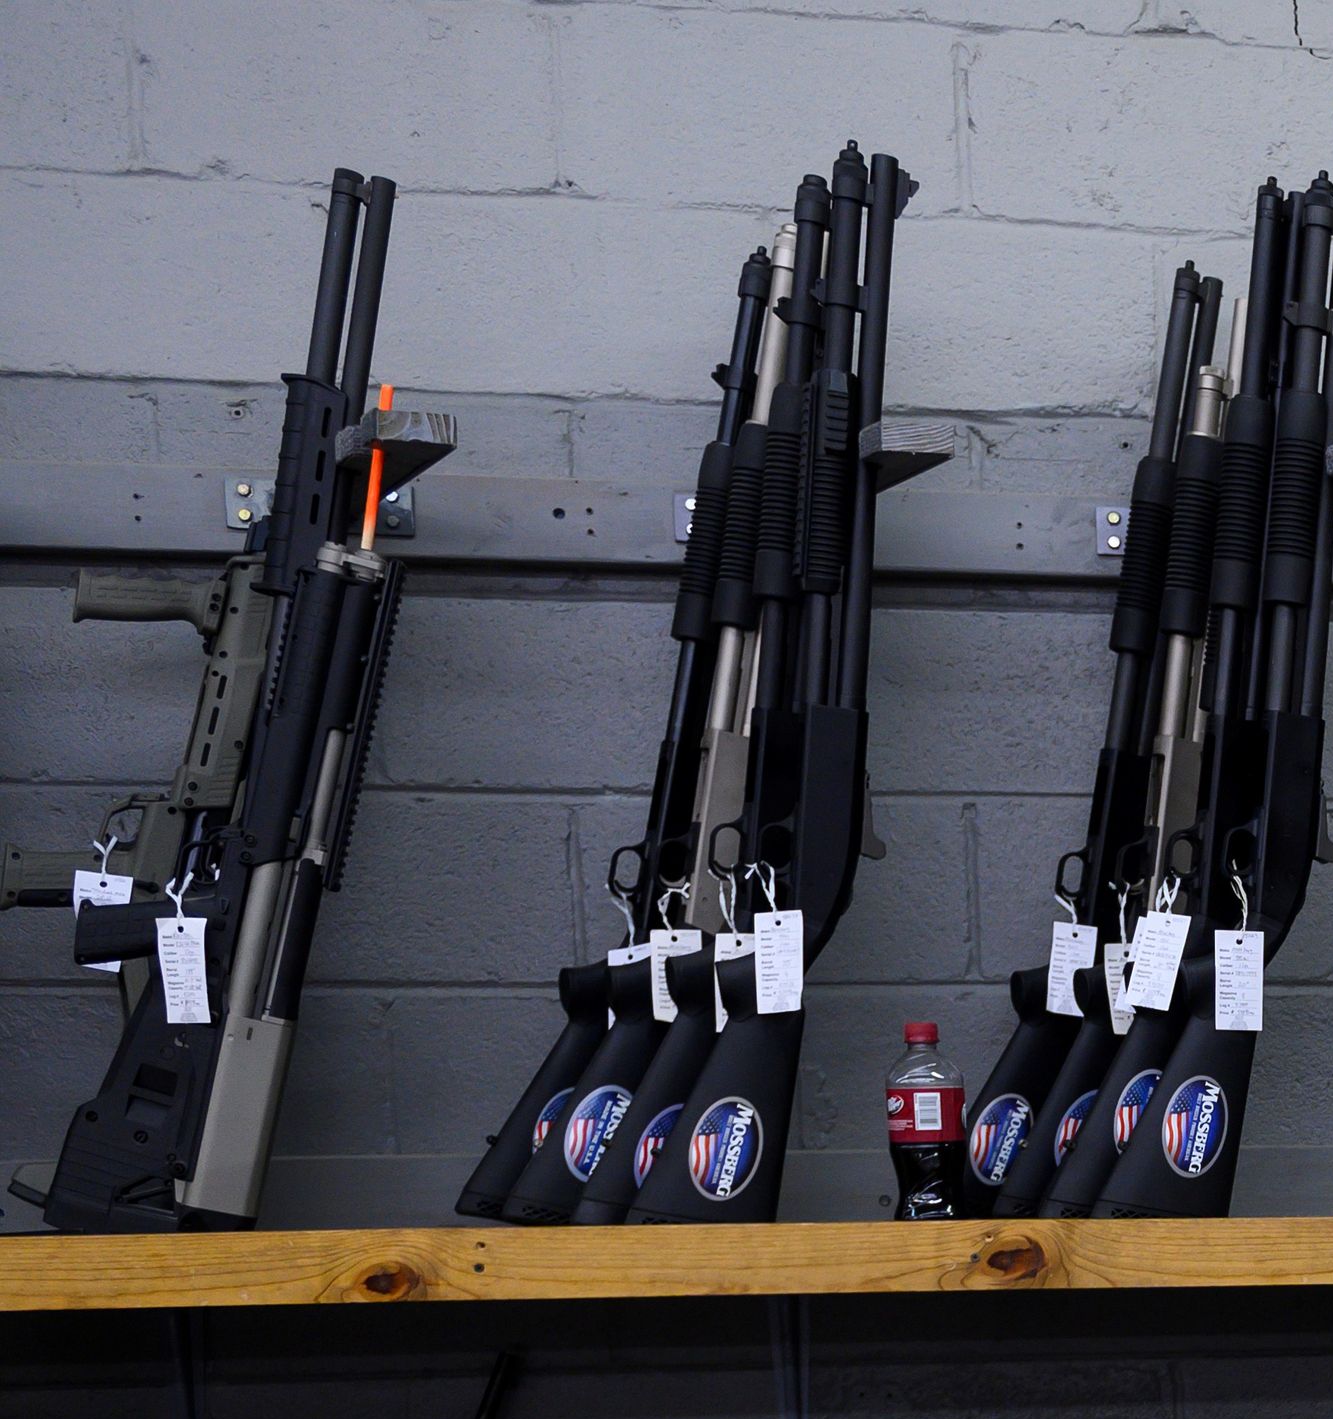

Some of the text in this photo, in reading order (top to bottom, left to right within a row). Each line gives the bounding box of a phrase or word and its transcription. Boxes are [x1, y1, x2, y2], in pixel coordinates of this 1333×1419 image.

[717, 1102, 754, 1197] MOSSBERG
[990, 1099, 1031, 1182] MOSSBERG
[1188, 1081, 1221, 1174] MOSSBERG
